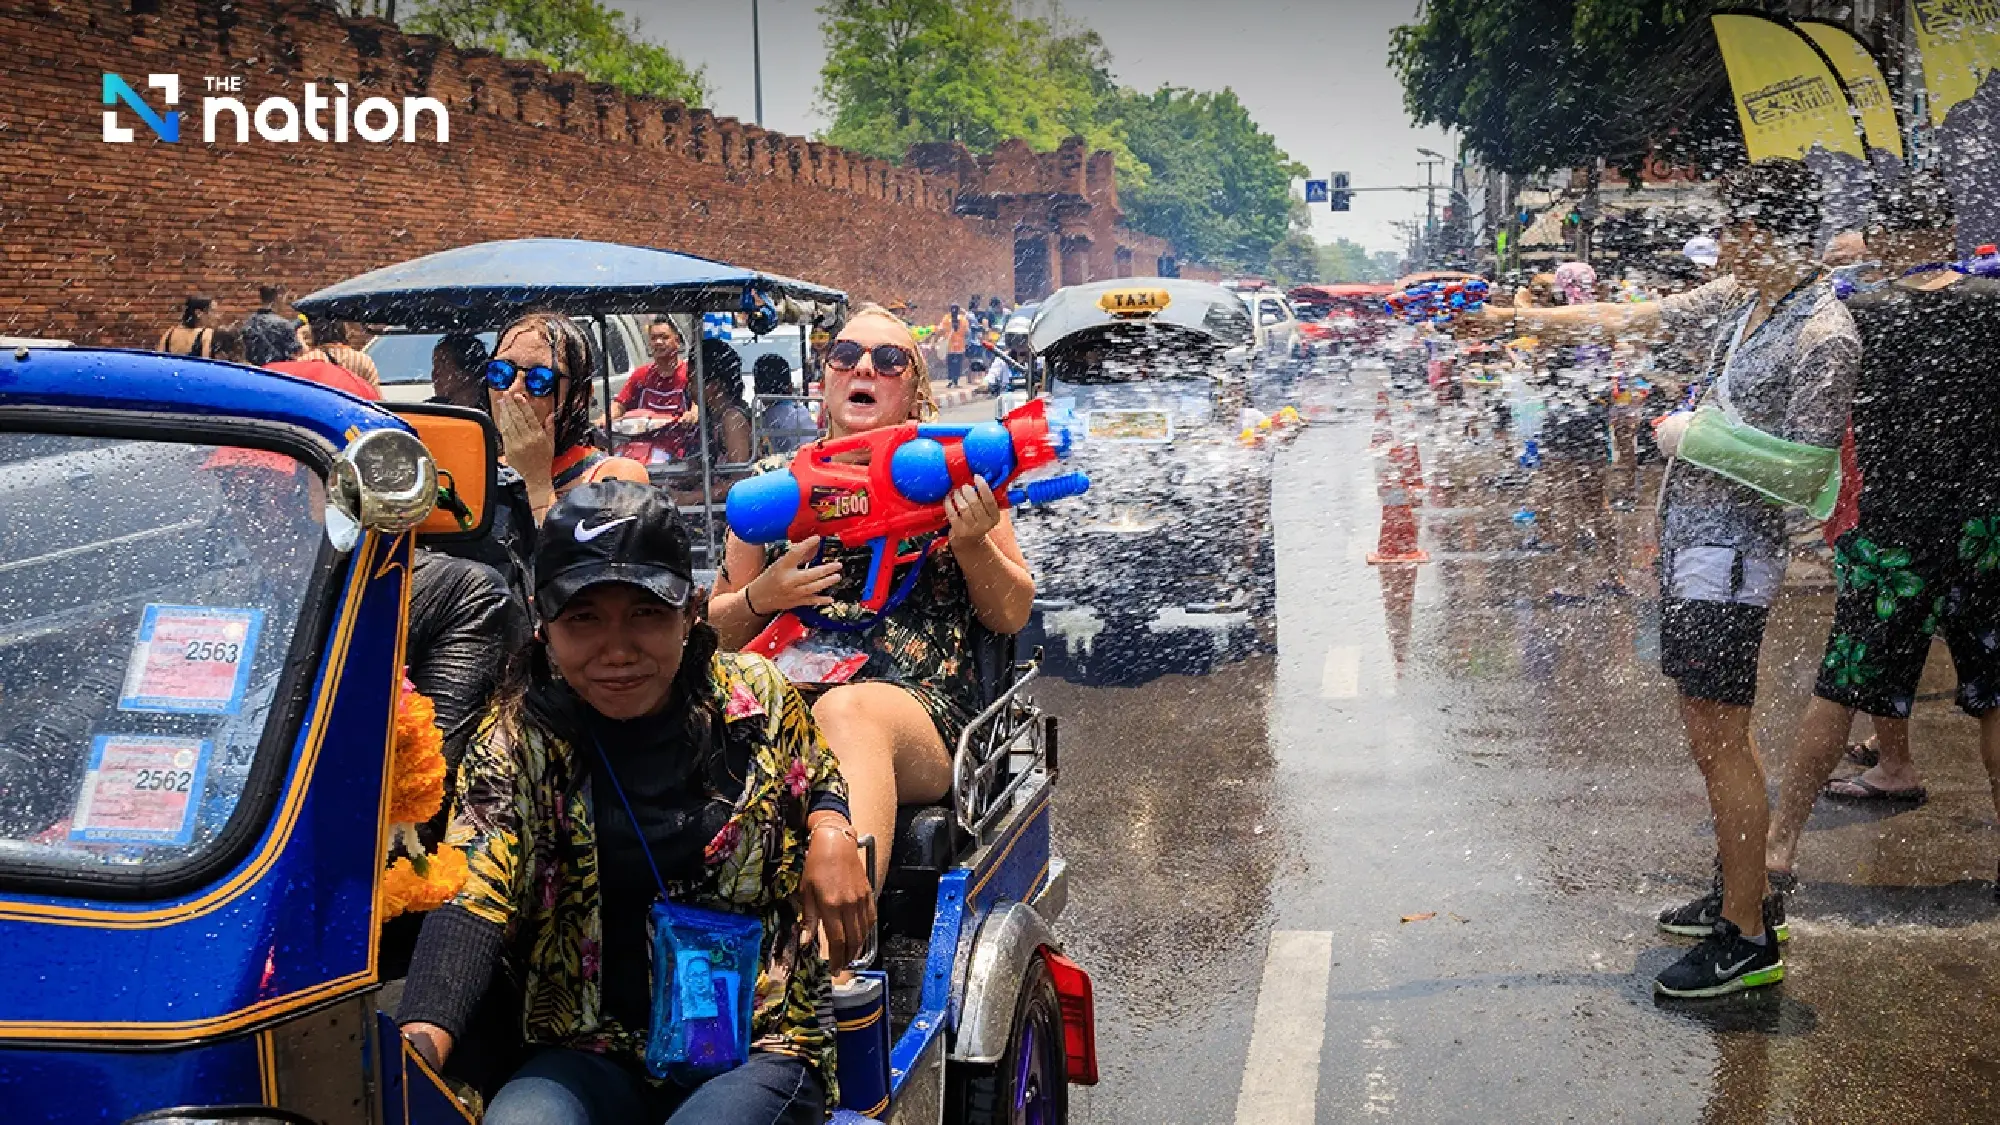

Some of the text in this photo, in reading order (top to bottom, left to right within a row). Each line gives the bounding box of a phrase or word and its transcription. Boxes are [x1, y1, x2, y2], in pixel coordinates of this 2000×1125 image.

[1114, 293, 1156, 307] TAXI
[185, 641, 239, 664] 2563
[134, 769, 192, 792] 2562
